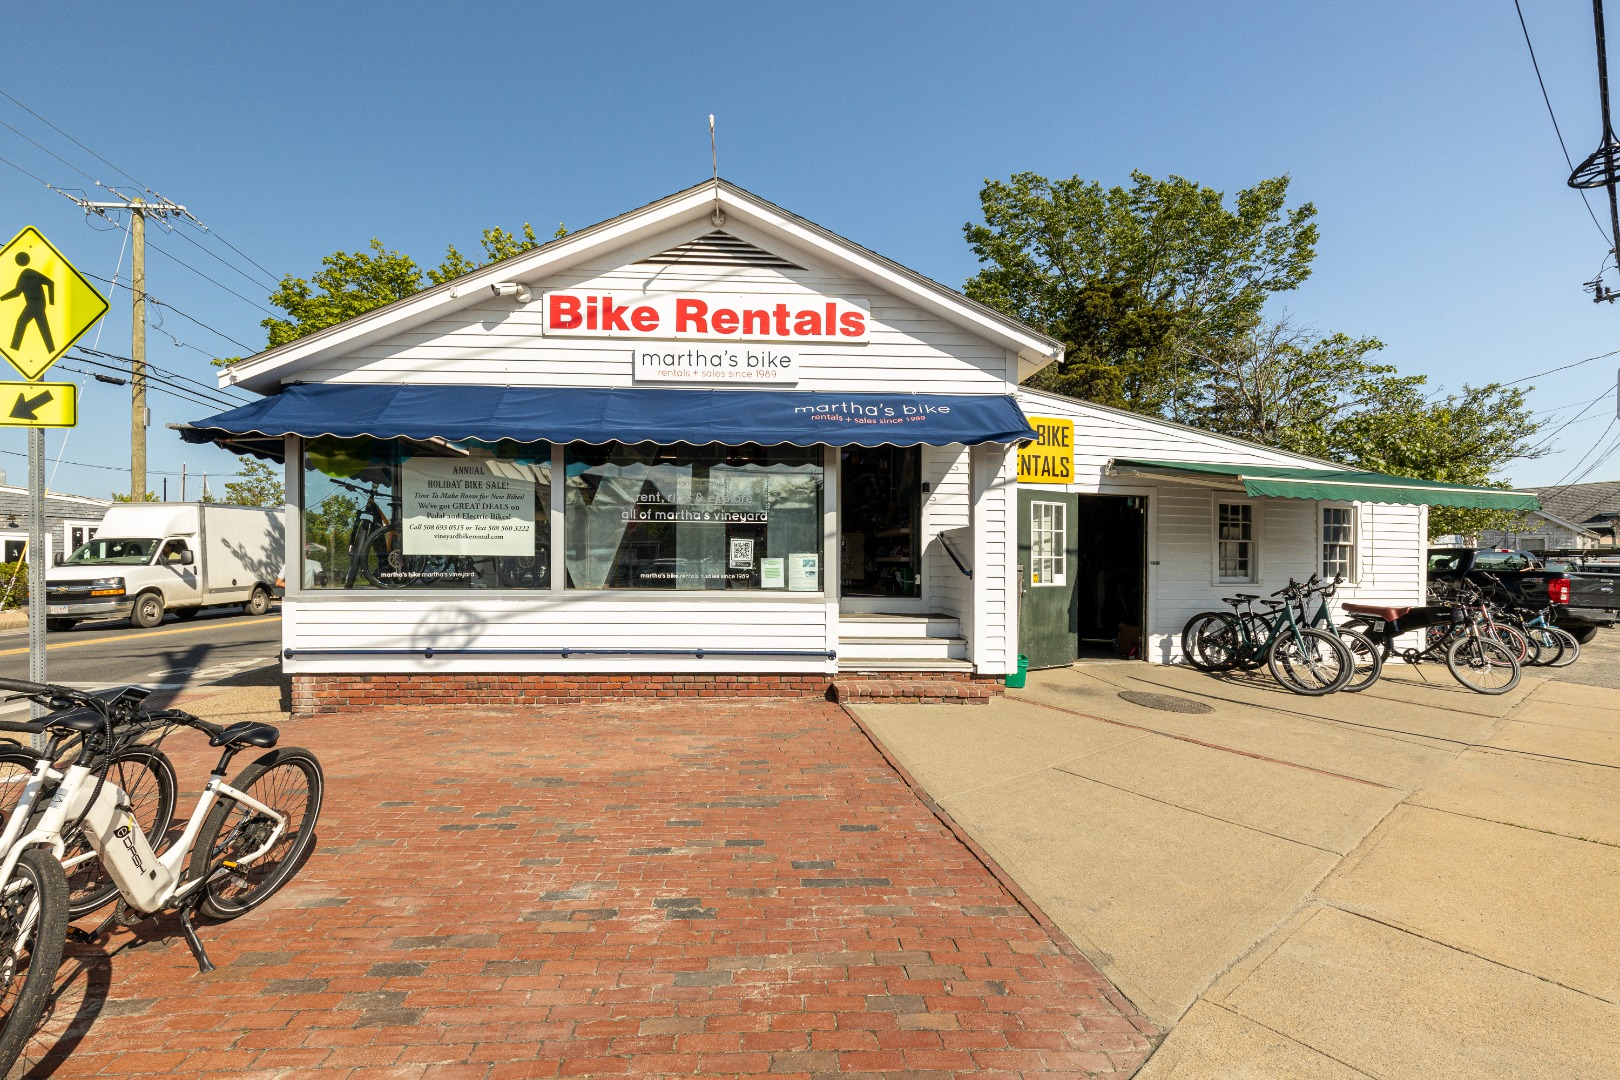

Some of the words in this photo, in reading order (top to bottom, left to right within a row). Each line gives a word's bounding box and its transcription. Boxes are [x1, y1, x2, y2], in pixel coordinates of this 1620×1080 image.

[549, 295, 660, 332] Bike
[675, 298, 866, 336] Rentals
[642, 350, 738, 367] martha's
[747, 351, 791, 368] bike
[657, 369, 690, 377] rentals
[702, 369, 725, 378] sales
[728, 370, 752, 379] since
[756, 370, 777, 379] 1989
[794, 402, 894, 416] martha's
[903, 404, 950, 414] bike
[811, 413, 842, 421] rentals
[854, 416, 877, 424] sales
[1037, 424, 1070, 448] BIKE
[428, 480, 462, 488] HOLIDAY
[465, 481, 482, 489] BIKE
[637, 493, 664, 504] rent,
[696, 493, 703, 503] &
[622, 509, 636, 520] all
[639, 509, 651, 520] of
[656, 510, 710, 520] martha's
[714, 511, 767, 523] vineyard
[123, 836, 146, 876] DASH
